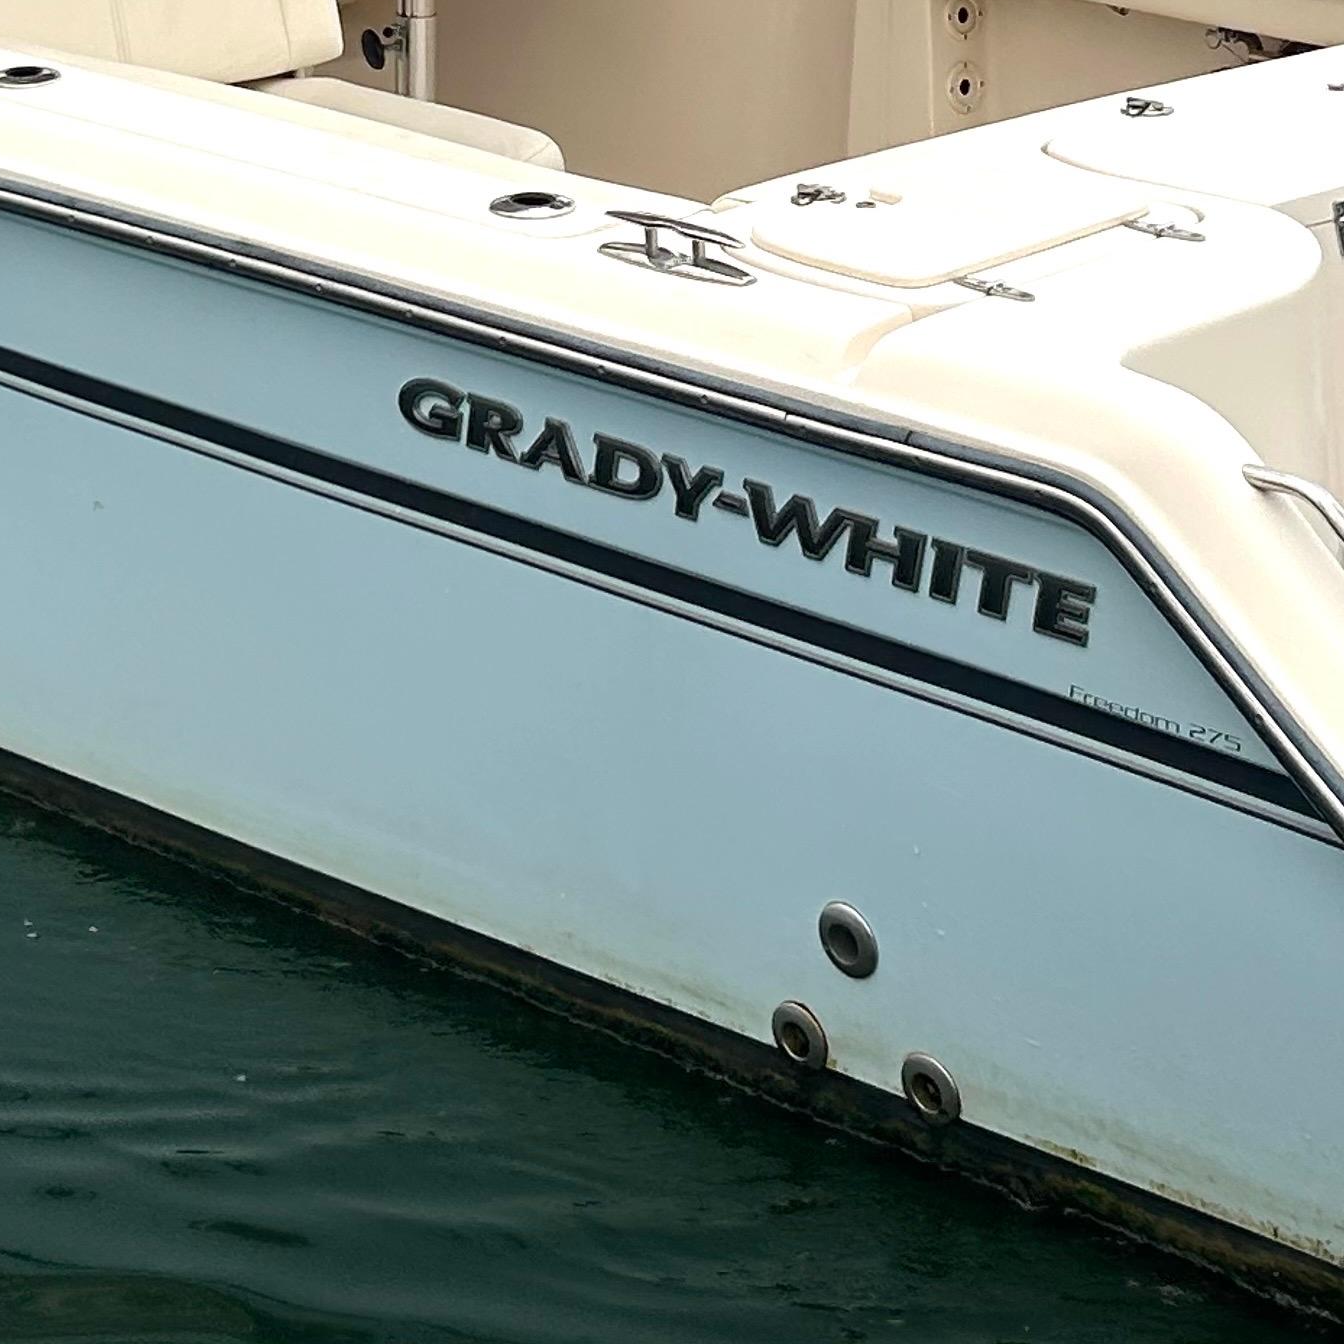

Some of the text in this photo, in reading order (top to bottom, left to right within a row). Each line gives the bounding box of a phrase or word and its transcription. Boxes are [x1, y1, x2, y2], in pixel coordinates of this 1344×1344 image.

[398, 376, 1098, 648] GRADY-WHITE
[1069, 684, 1241, 753] Freedom 275
